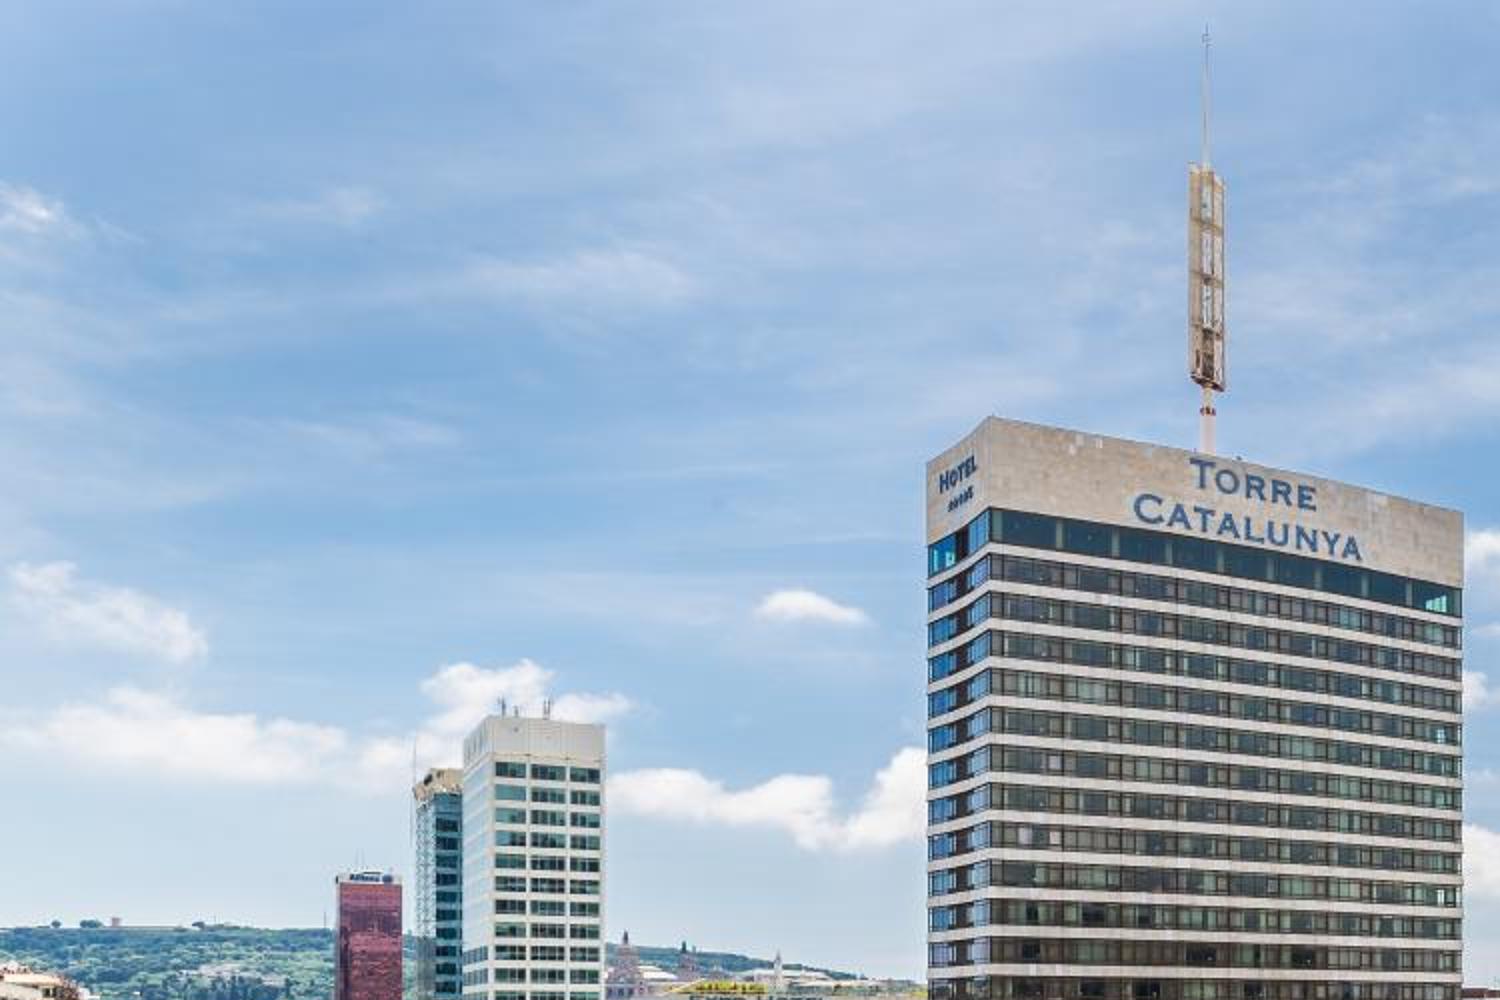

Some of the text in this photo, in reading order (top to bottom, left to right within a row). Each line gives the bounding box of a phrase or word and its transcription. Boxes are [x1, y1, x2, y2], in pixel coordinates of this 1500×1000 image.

[939, 455, 976, 494] HOTEL
[1190, 457, 1317, 512] TORRE
[1133, 493, 1362, 561] CATALUNYA
